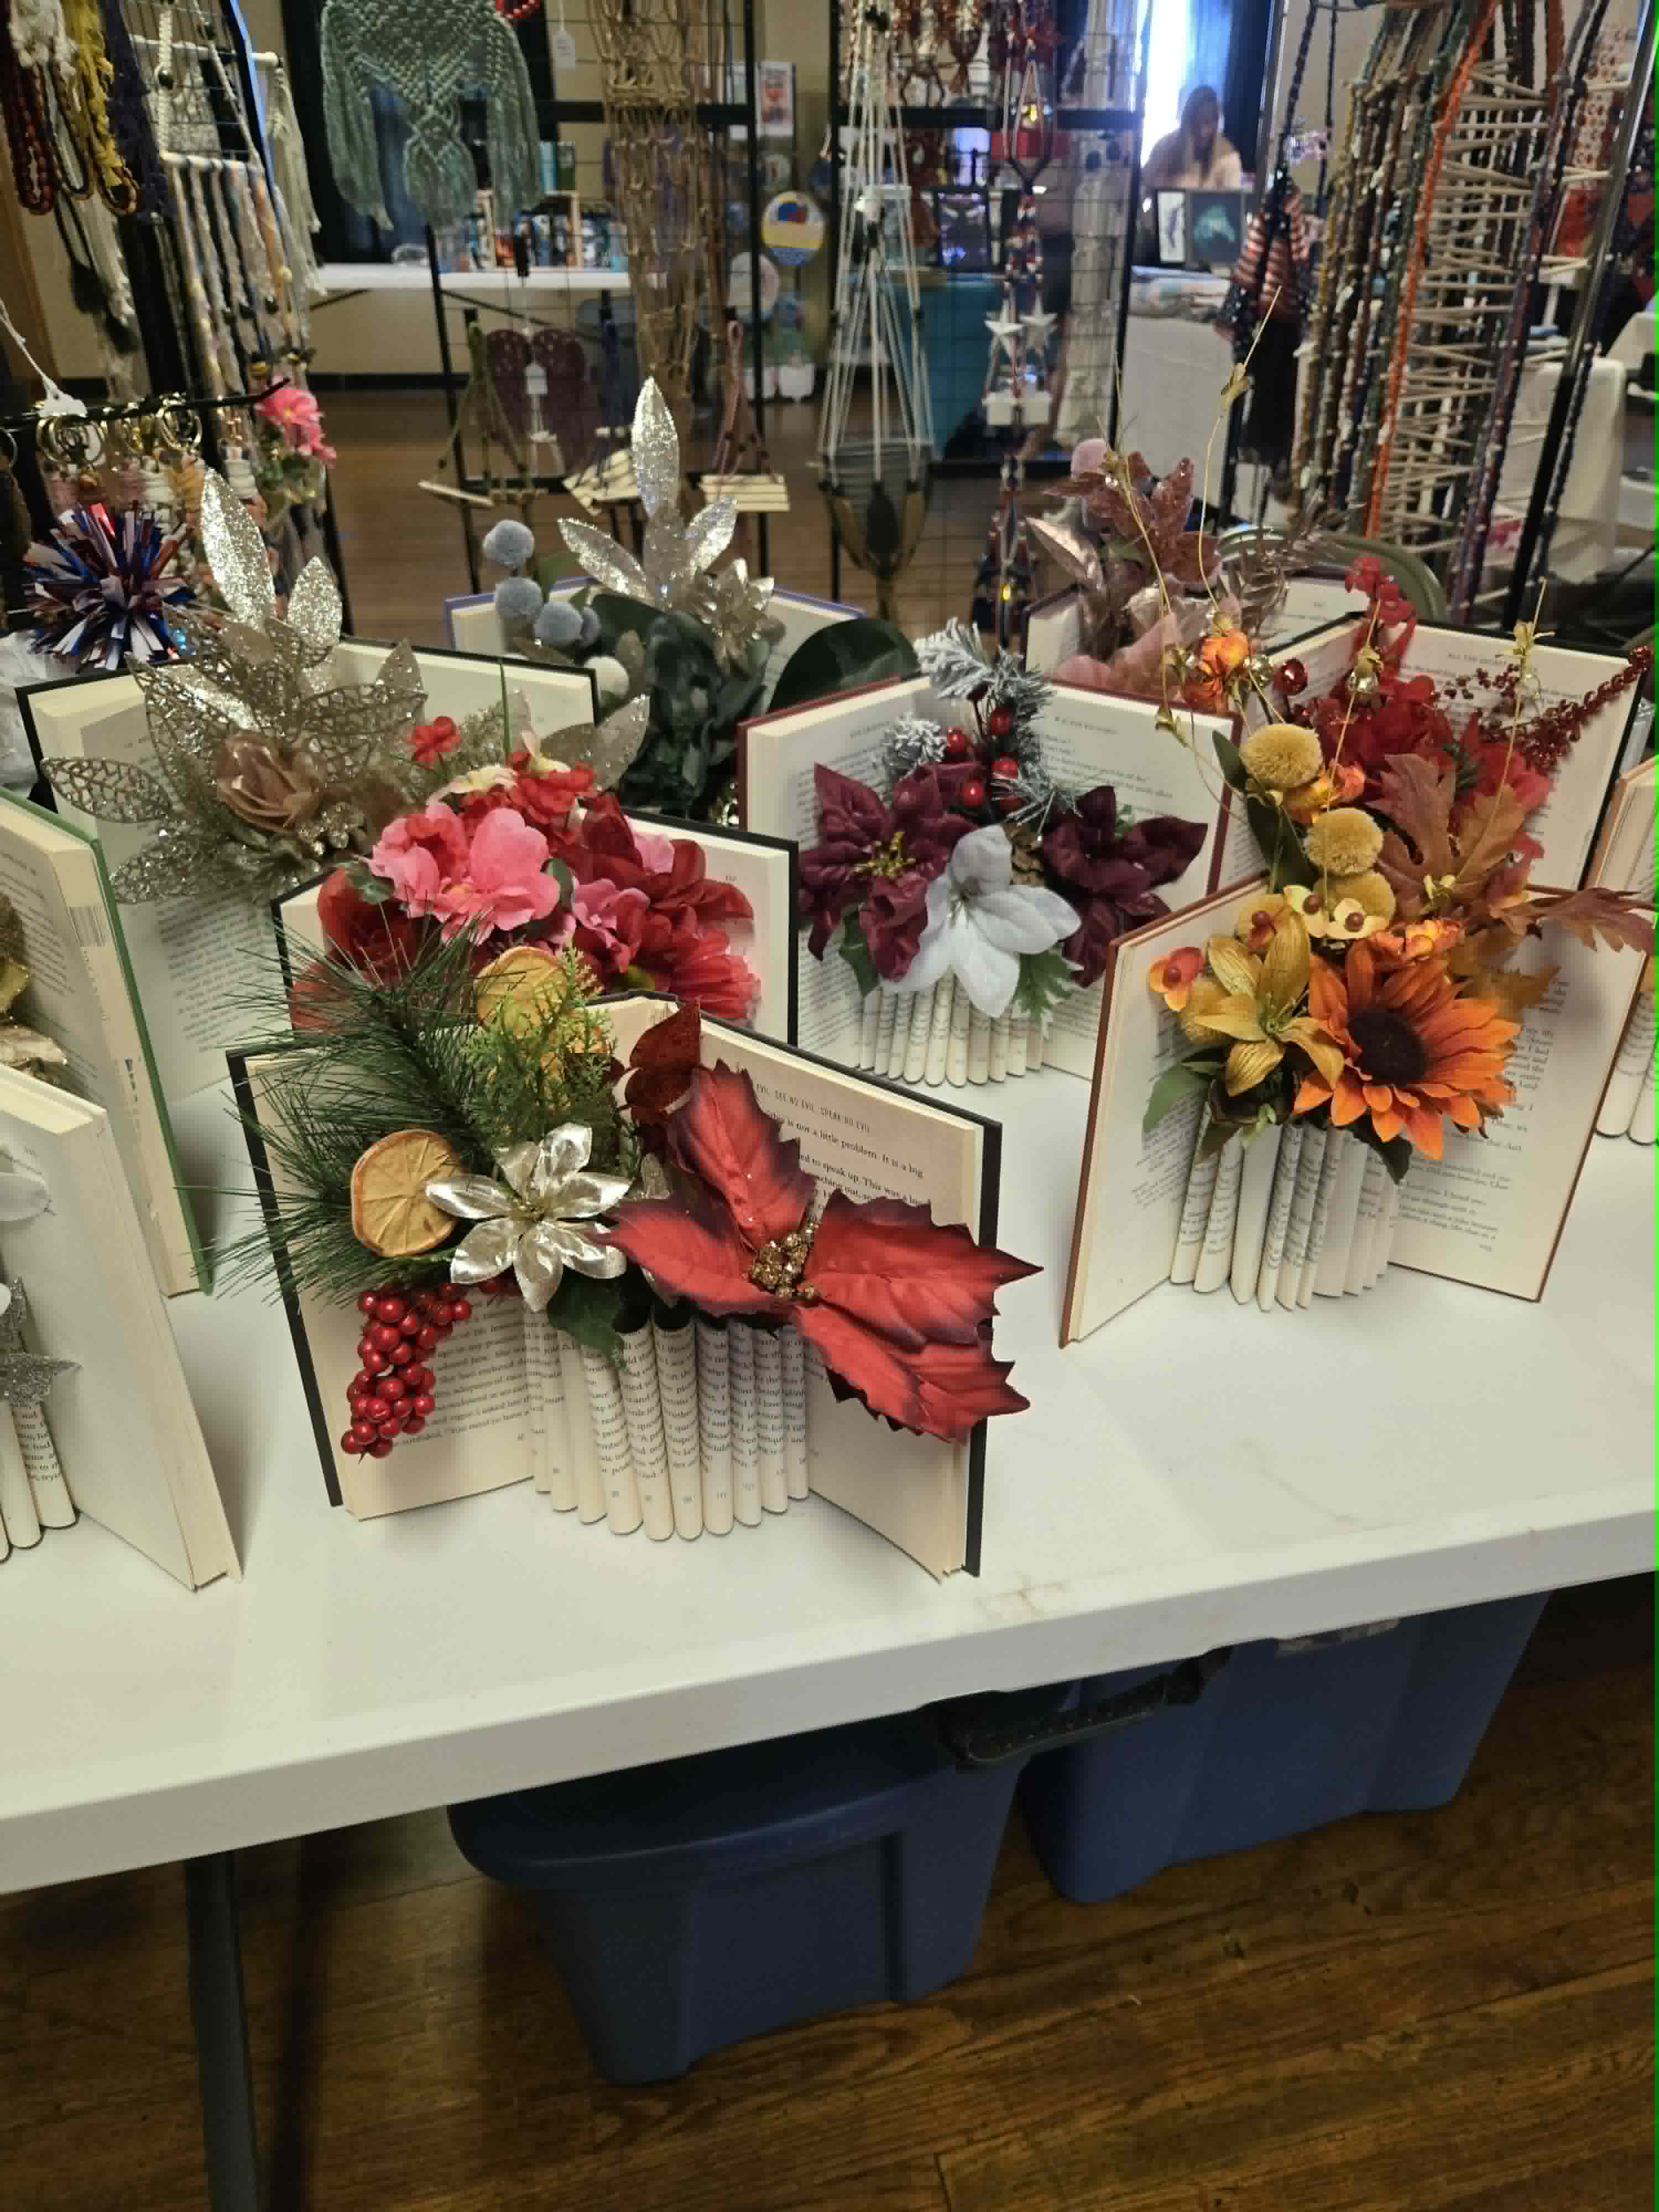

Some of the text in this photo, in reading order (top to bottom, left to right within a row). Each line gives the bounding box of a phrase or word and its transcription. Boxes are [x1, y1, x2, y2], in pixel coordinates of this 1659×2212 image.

[796, 1123, 811, 1134] not
[818, 1128, 839, 1144] little
[823, 1162, 847, 1178] speak
